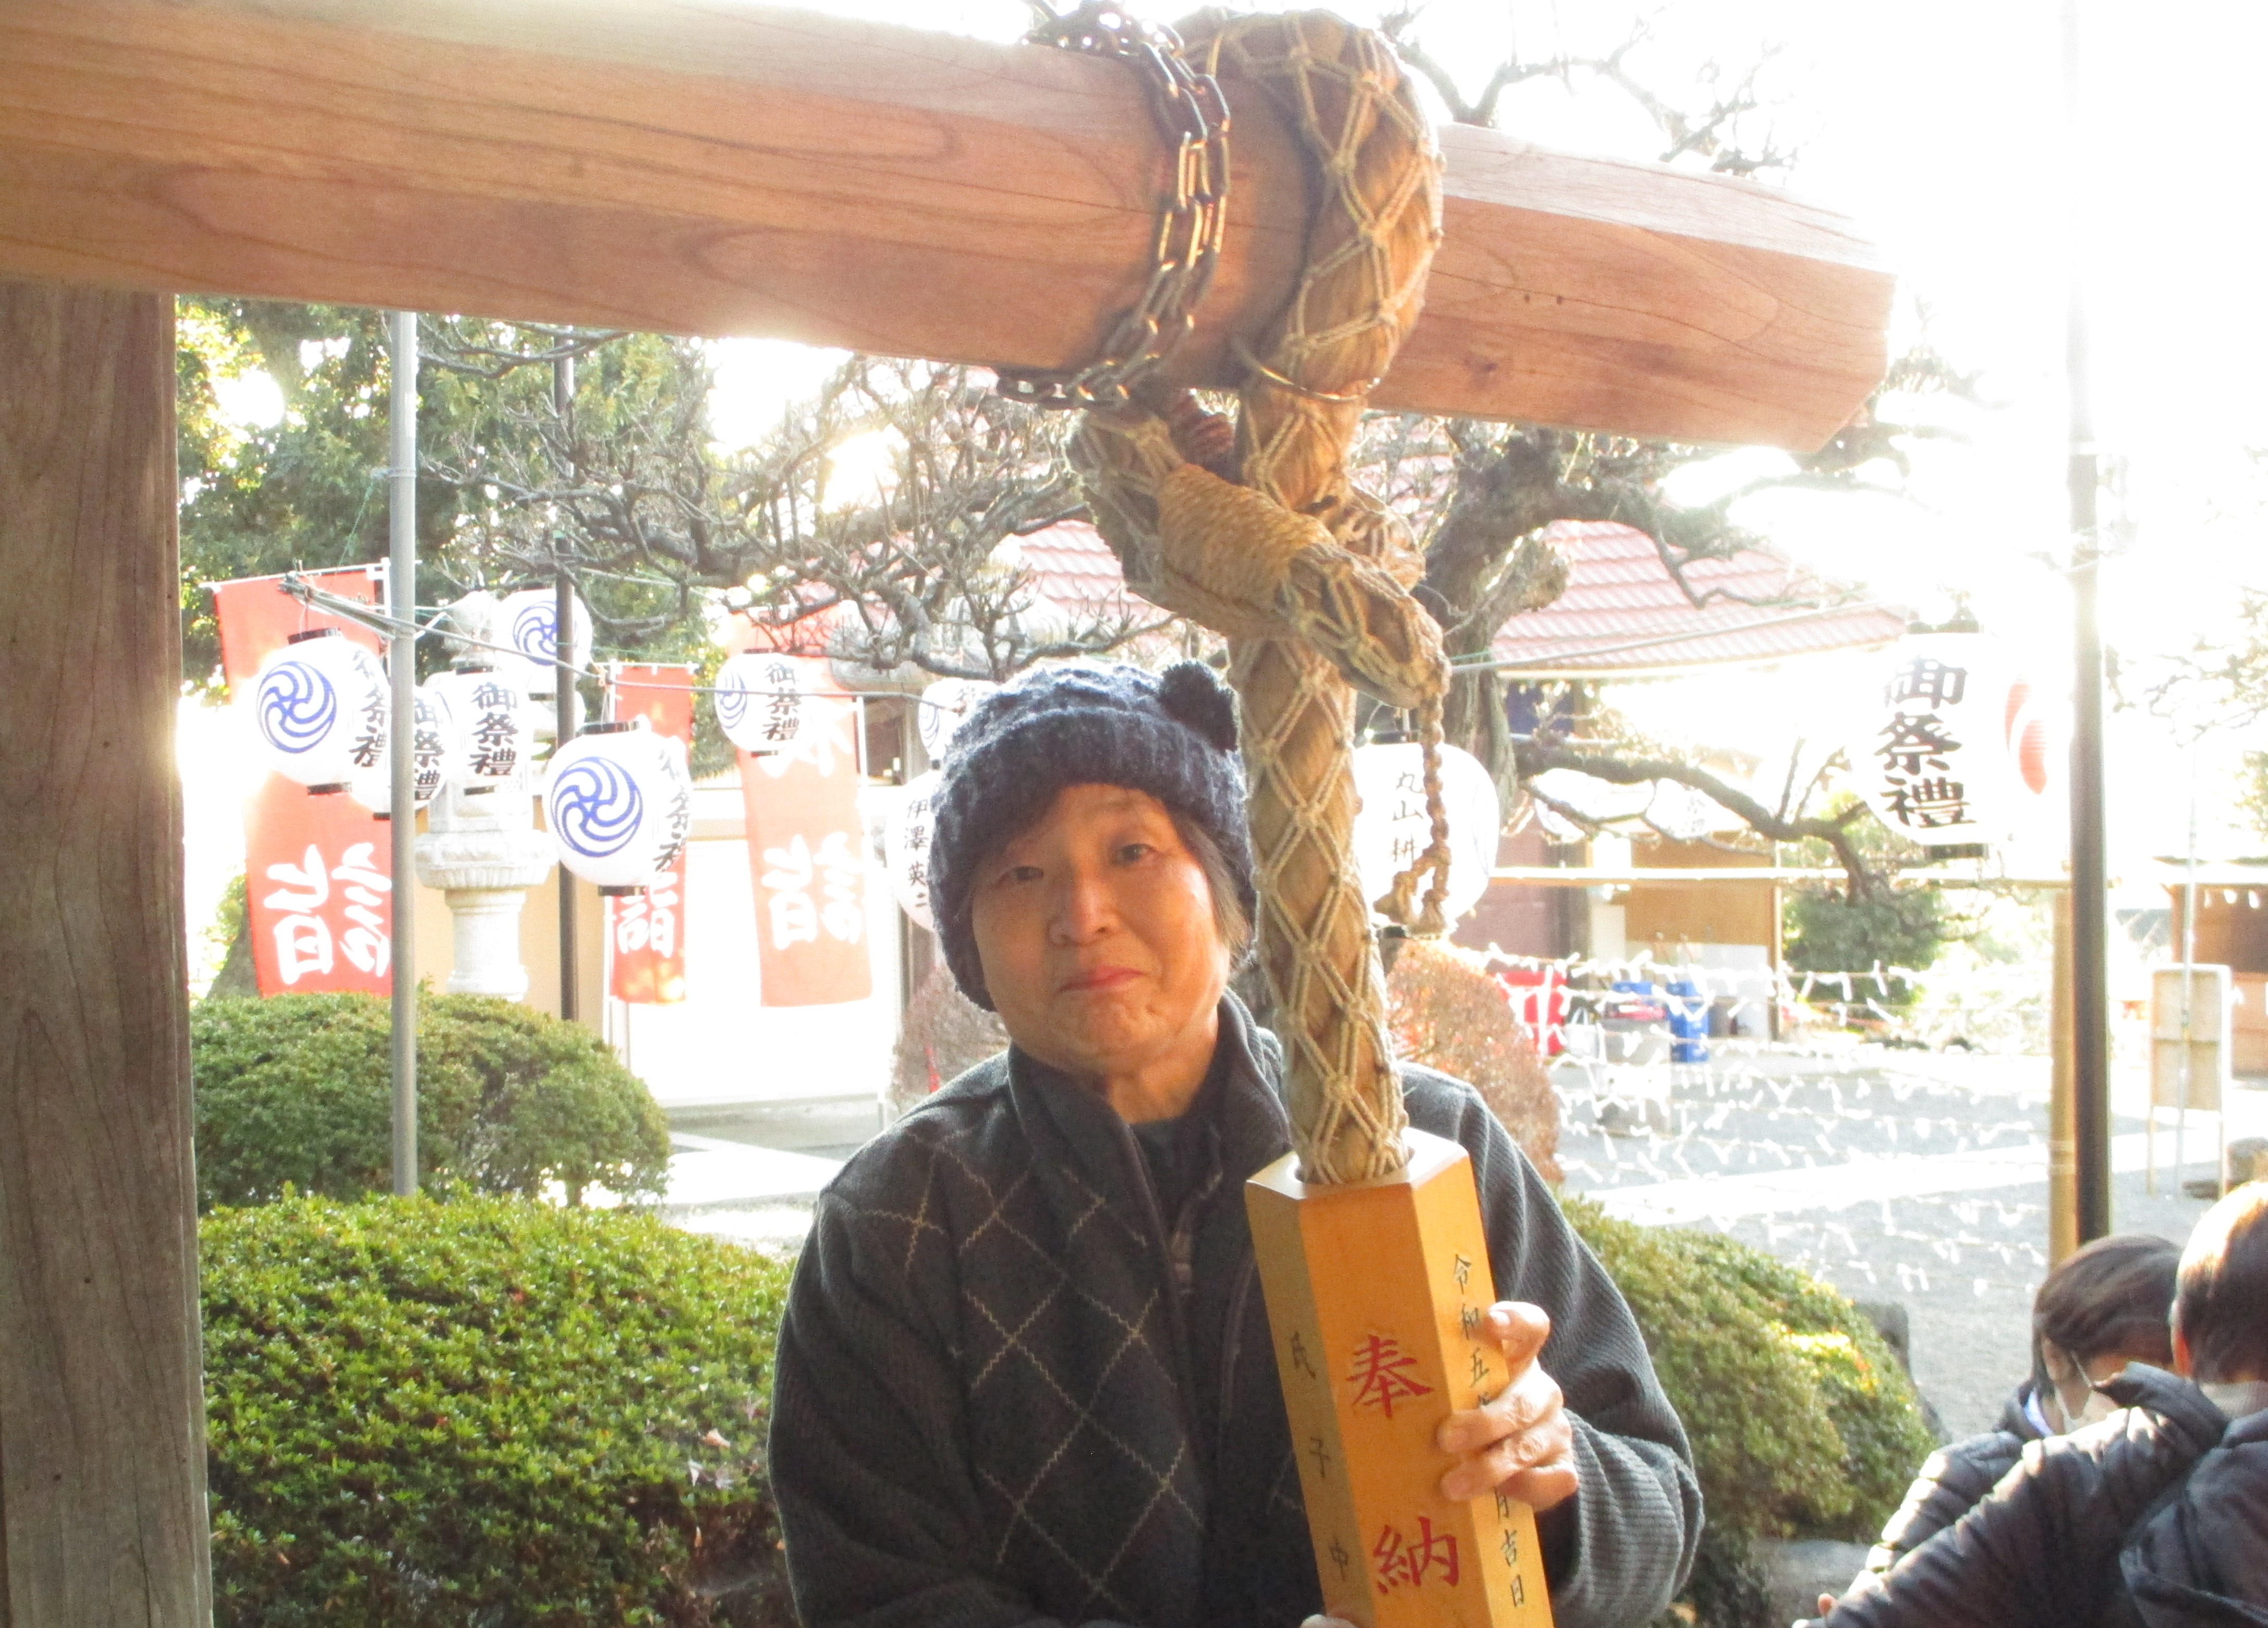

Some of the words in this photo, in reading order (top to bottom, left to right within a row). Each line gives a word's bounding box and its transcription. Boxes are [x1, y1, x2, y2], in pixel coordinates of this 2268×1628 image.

[468, 681, 519, 776] 御祭禮
[761, 662, 802, 742] 御祭禮
[1873, 654, 1977, 828] 御祭禮
[904, 799, 929, 908] 伊澤英二
[1346, 1333, 1460, 1594] 奉納
[1454, 1253, 1525, 1608] 令和五月吉日
